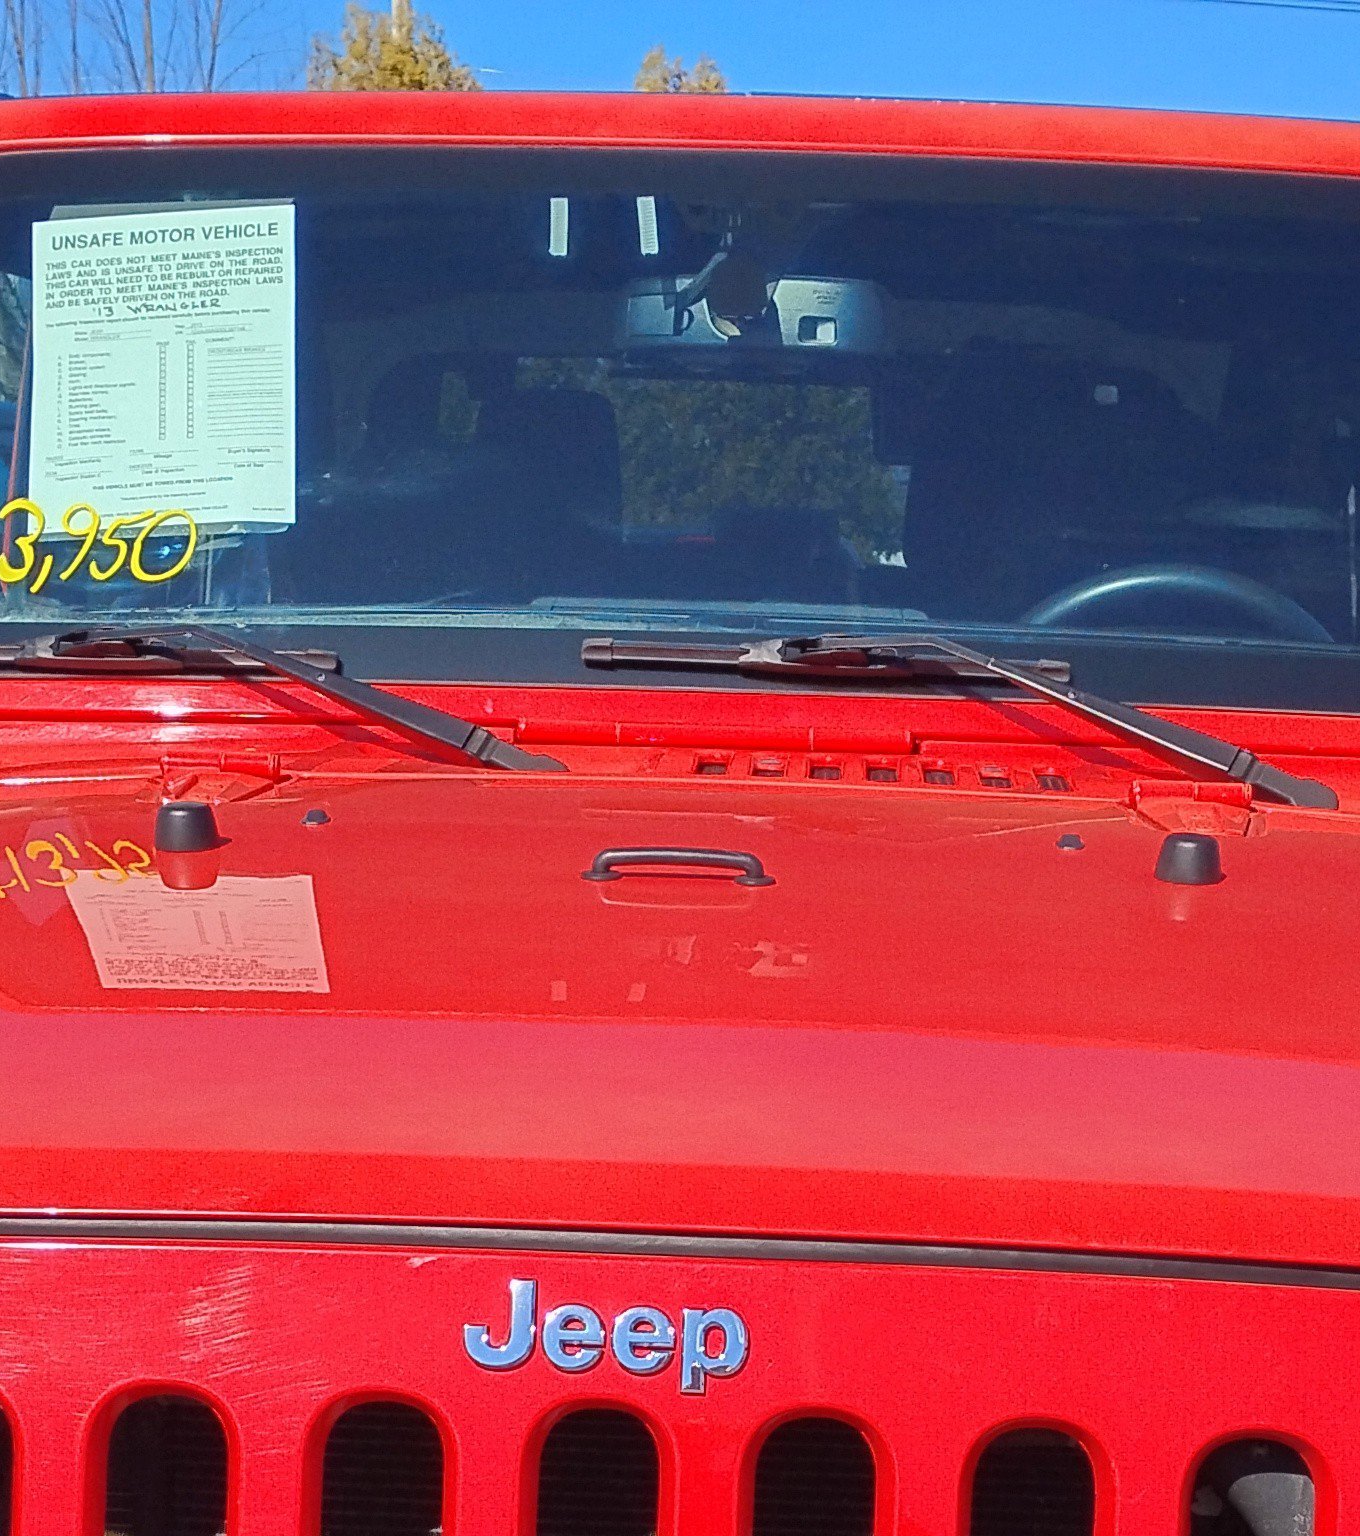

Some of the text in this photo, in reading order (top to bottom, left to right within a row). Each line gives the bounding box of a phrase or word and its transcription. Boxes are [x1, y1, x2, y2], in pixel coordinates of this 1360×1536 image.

[52, 222, 279, 250] UNSAFE MOTOR VEHICLE
[46, 246, 284, 271] THIS CAR DOES NOT MEET MAINE'S INSPECTION
[46, 256, 283, 281] LAWS AND IS UNSAFE TO DRIVE ON THE ROAD.
[45, 275, 284, 300] IN ORDER TO MEET MAINE'S INSPECTION LAWS
[46, 265, 284, 290] THIS CAR WILL NEED TO BE REBUILT OR REPAIRED
[45, 288, 230, 309] AND BE SAFELY DRIVEN ON THE ROAD.
[126, 298, 221, 314] WRANGLER
[463, 1278, 750, 1394] Jeep
